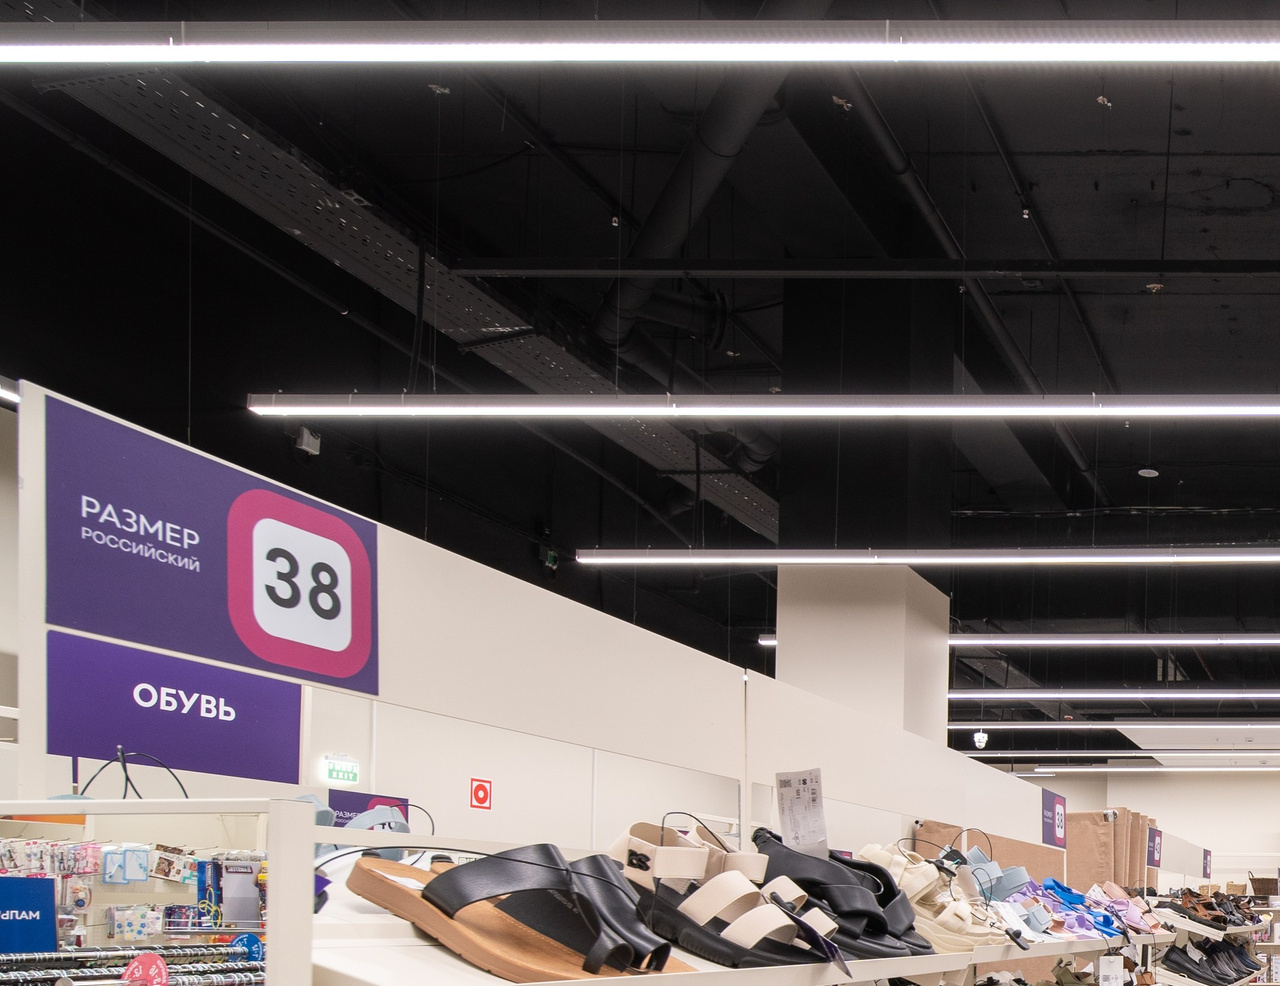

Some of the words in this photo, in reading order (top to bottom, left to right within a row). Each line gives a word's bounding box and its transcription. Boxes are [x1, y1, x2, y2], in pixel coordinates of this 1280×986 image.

[80, 494, 200, 550] РАЗМЕР
[80, 526, 201, 573] РОССИЙСКИЙ
[264, 547, 342, 621] 38
[132, 682, 237, 722] ОБУВЬ
[332, 771, 354, 780] EXIT
[335, 810, 360, 818] РАЗМЕ
[1056, 811, 1064, 830] 38
